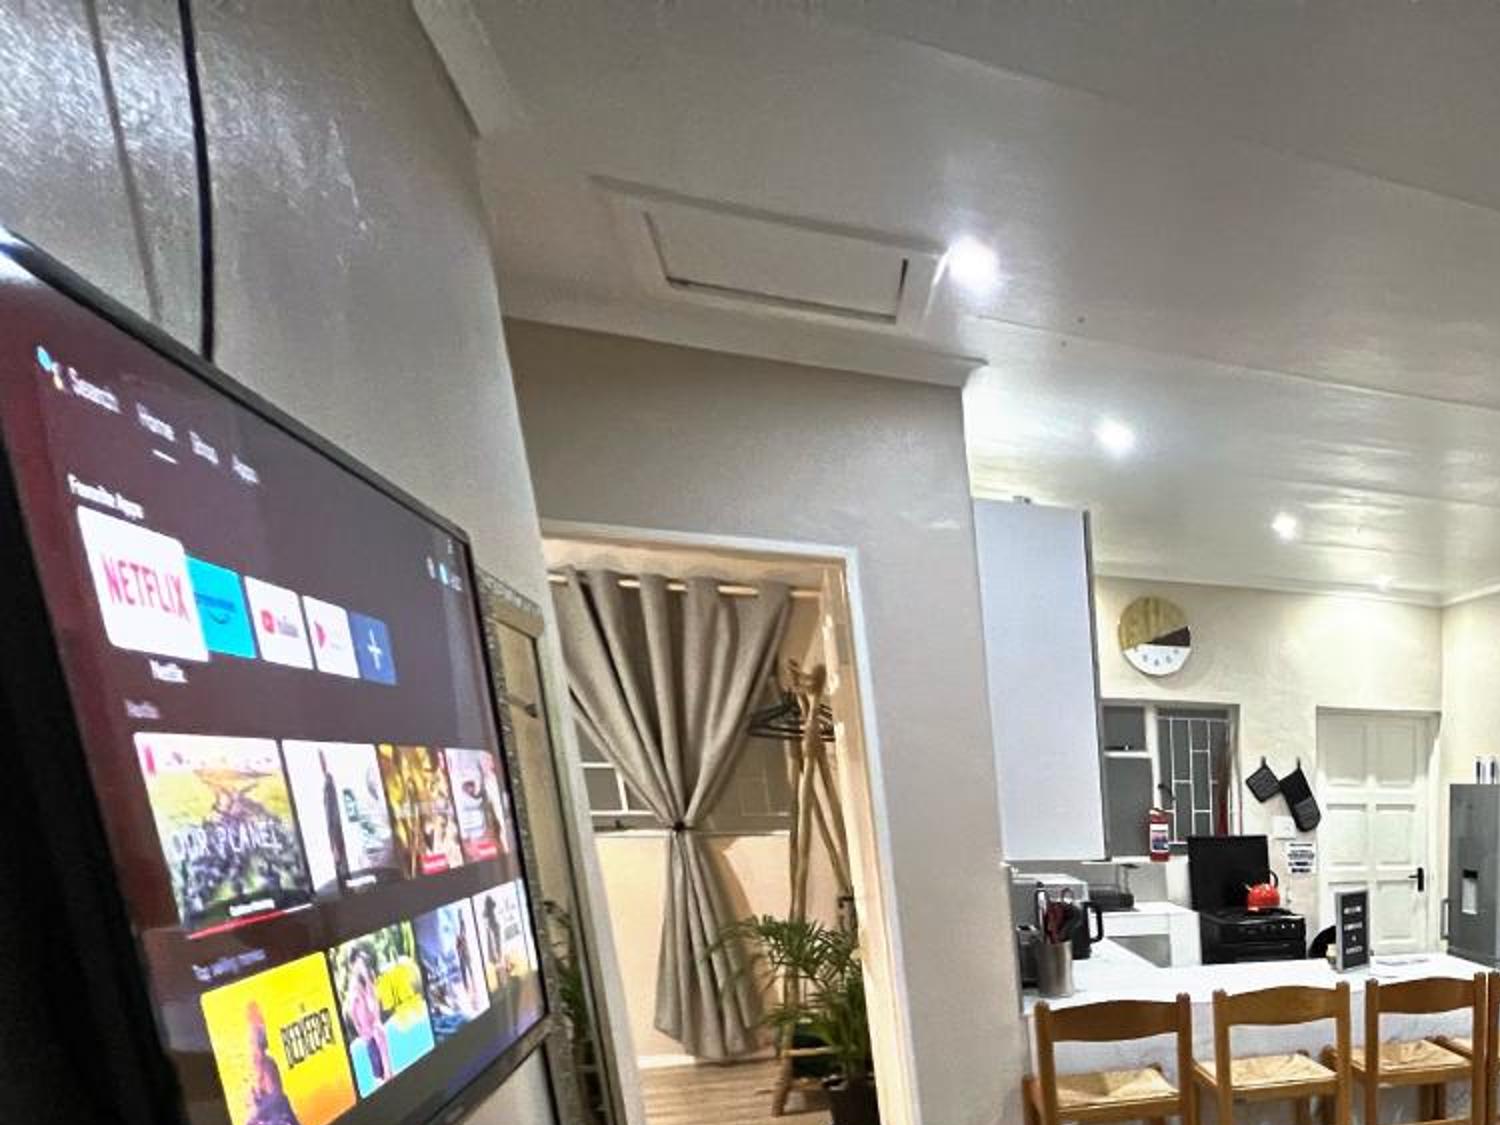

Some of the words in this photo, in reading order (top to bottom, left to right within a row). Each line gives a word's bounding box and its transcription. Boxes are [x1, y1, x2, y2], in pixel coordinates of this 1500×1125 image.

[102, 554, 190, 623] NETFLIX
[171, 823, 210, 861] OUR
[215, 820, 283, 858] PLANET
[279, 1007, 335, 1070] BEEKEEPER
